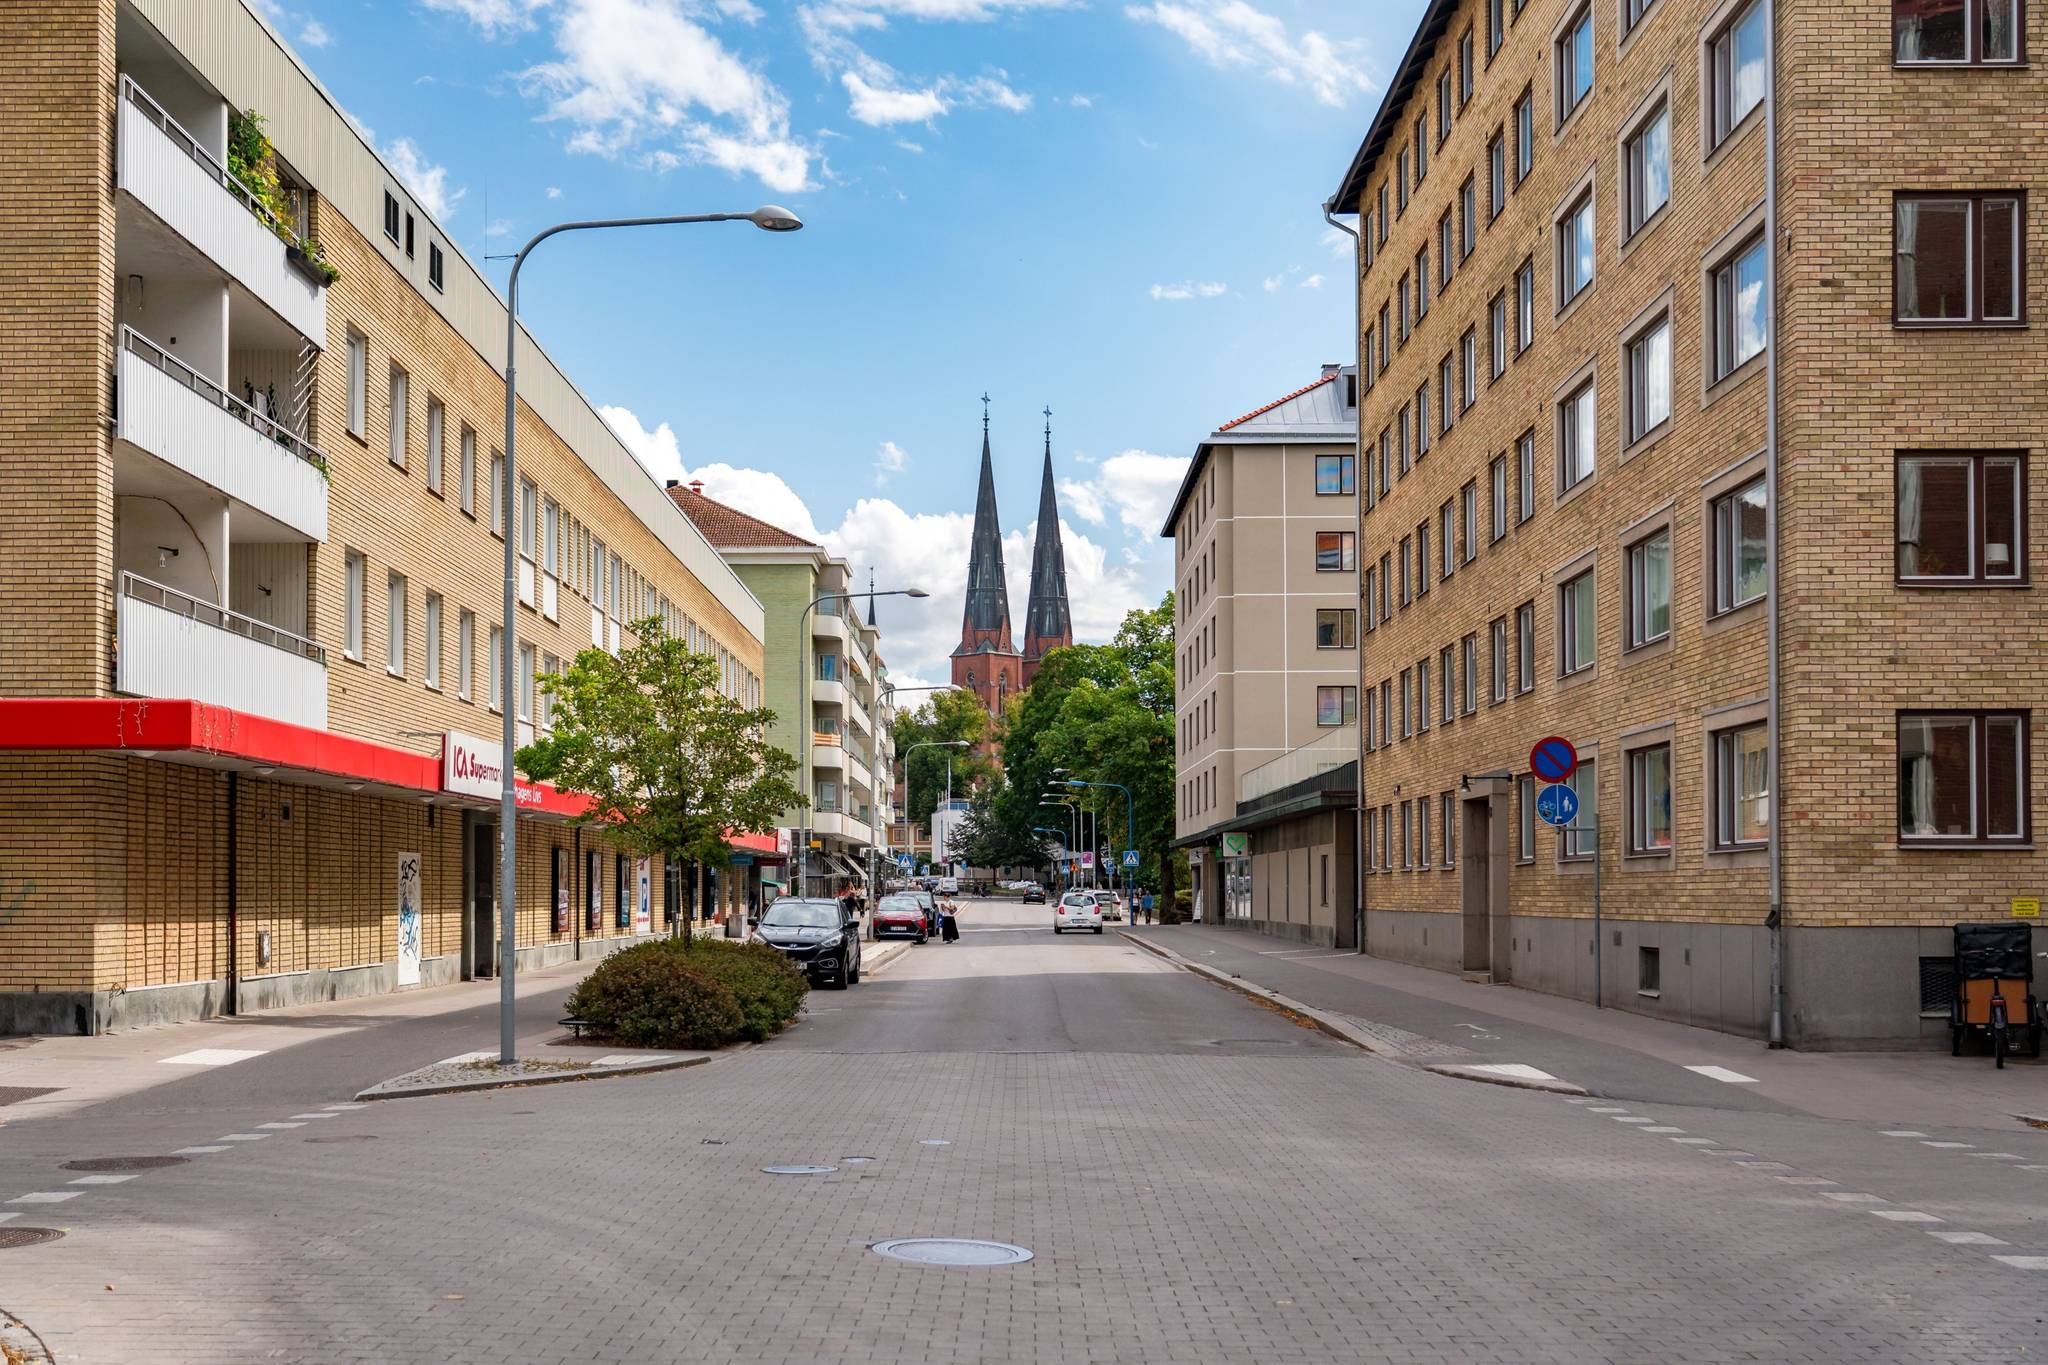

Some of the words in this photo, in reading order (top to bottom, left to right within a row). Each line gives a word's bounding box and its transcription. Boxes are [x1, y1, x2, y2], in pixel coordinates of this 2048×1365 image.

[453, 745, 469, 780] ICA
[470, 752, 504, 783] Supermark
[514, 781, 532, 803] hagens
[533, 785, 542, 803] Livs
